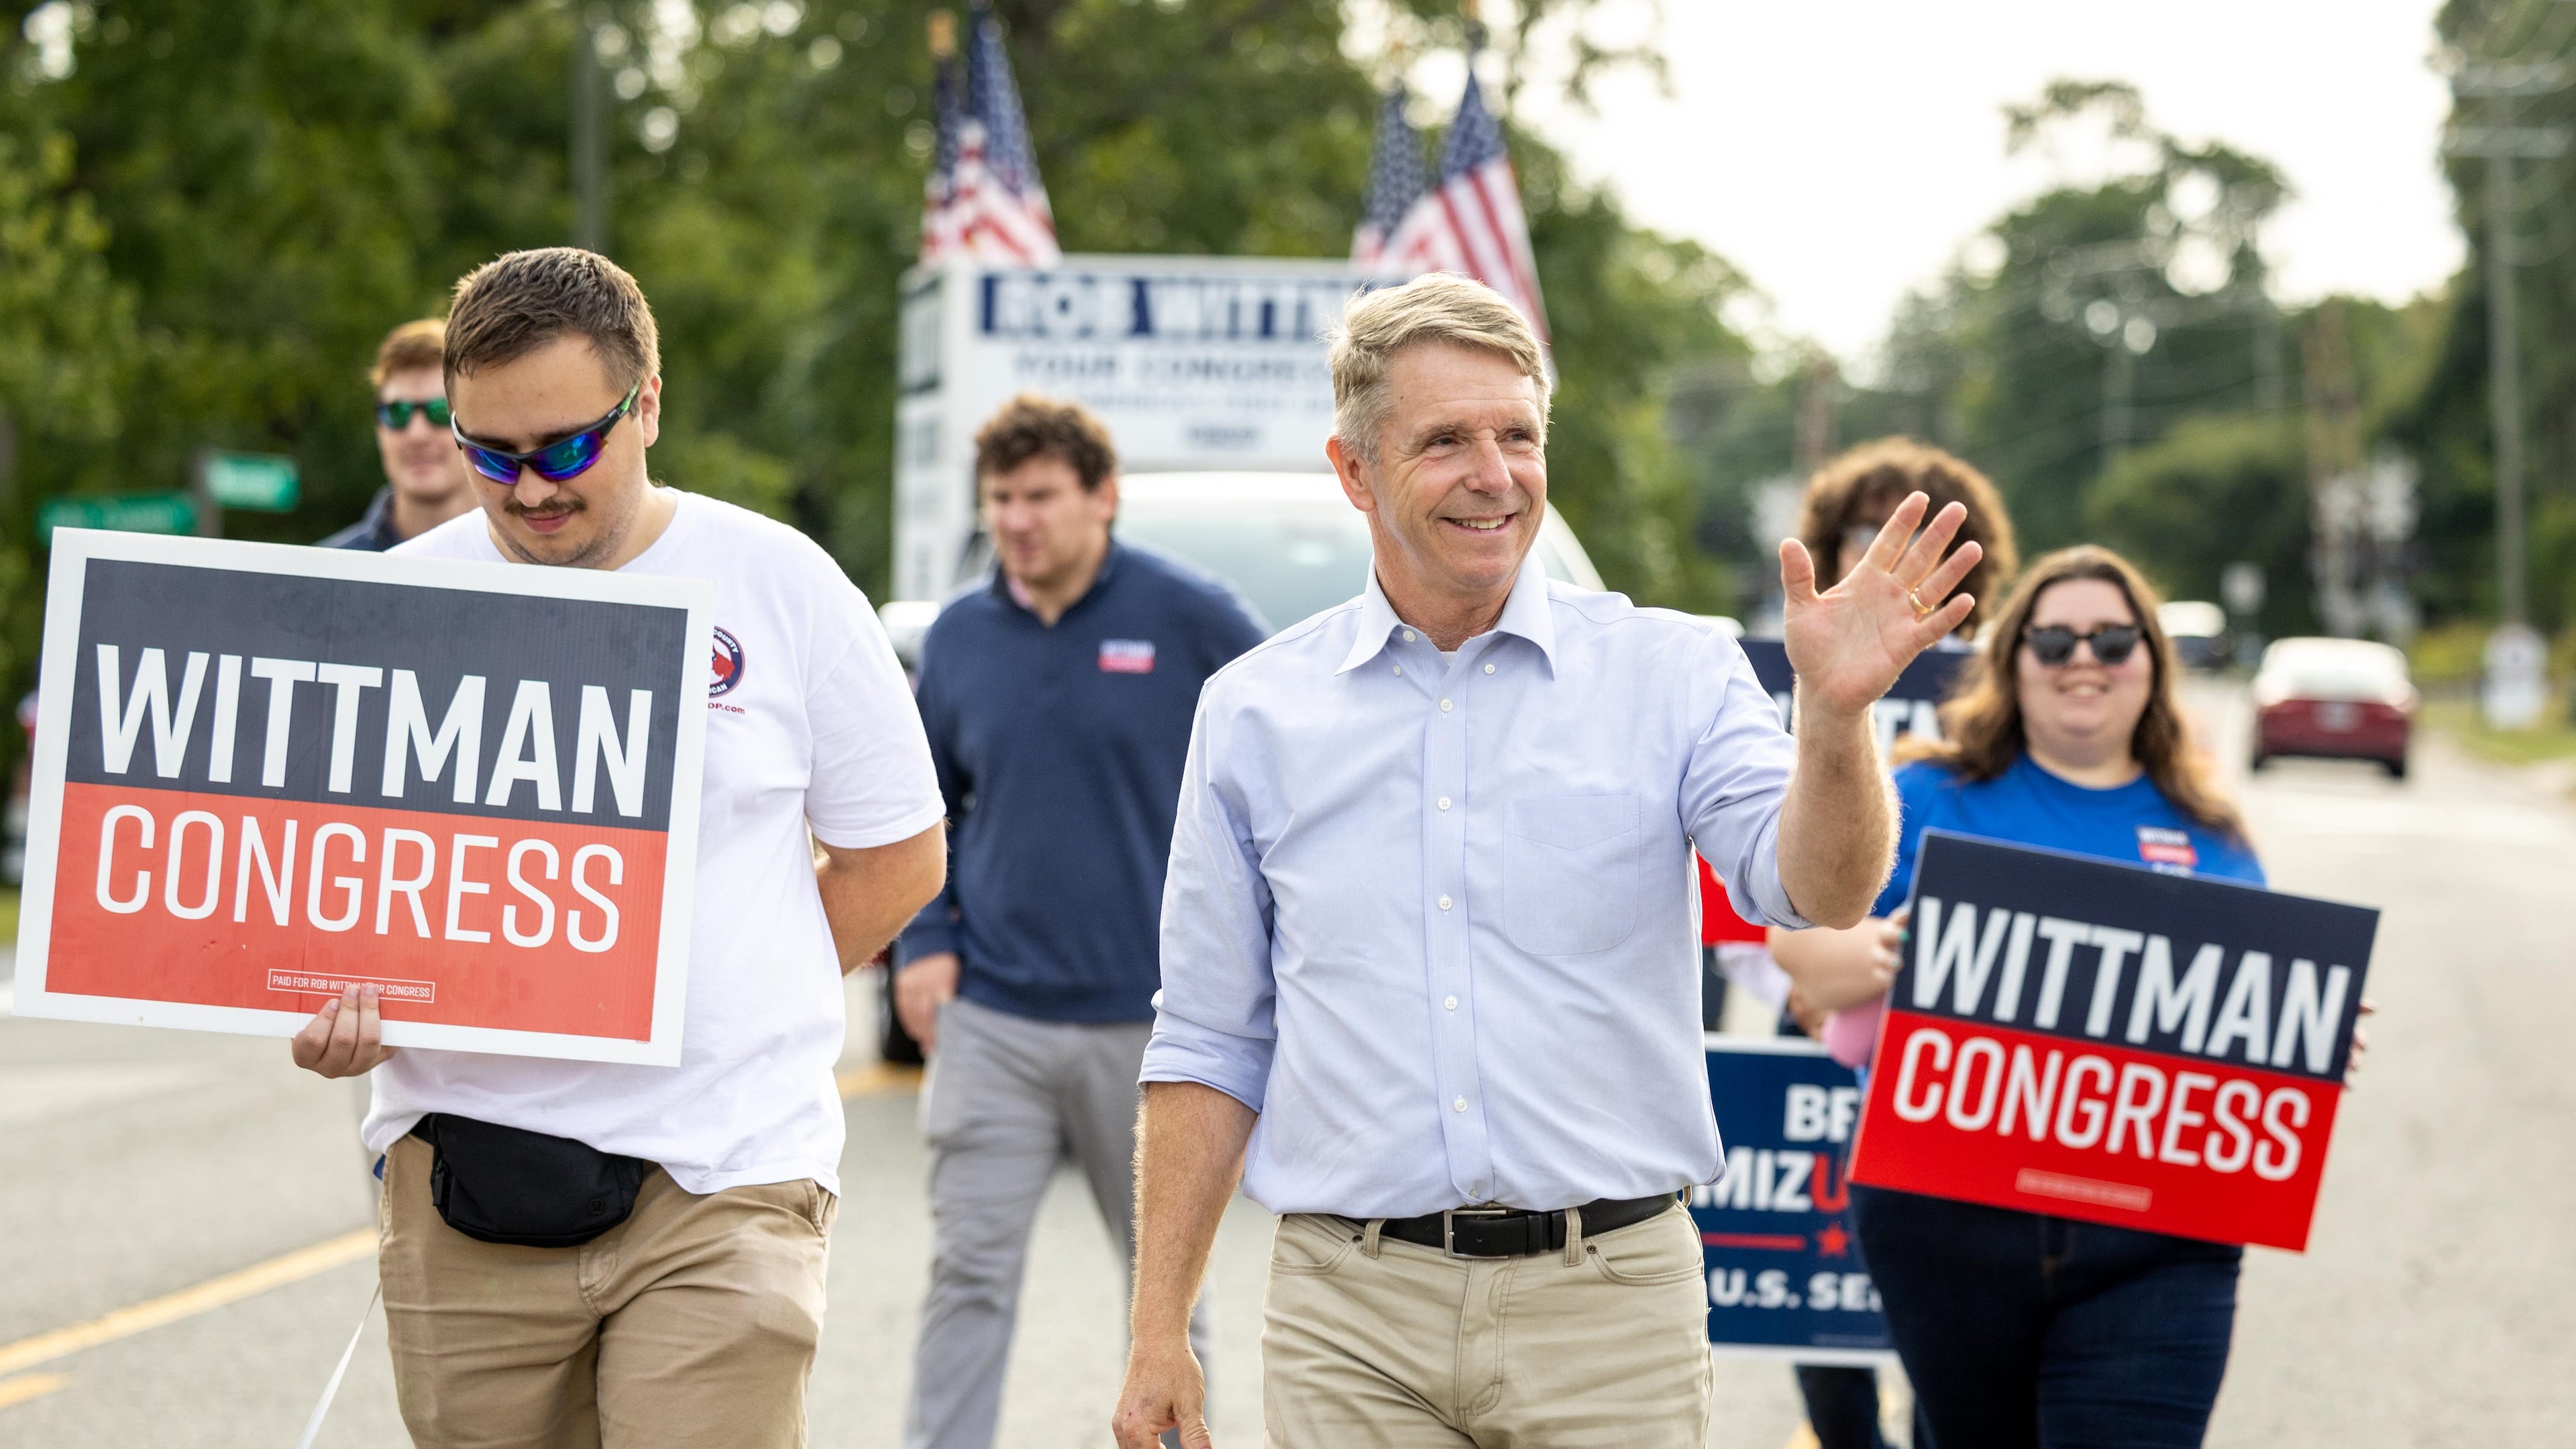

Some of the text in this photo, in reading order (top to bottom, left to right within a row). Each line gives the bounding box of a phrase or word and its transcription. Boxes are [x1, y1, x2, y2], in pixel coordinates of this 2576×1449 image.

[97, 644, 652, 817] WITTMAN
[95, 804, 624, 953] CONGRESS
[272, 975, 292, 987] PAID
[293, 977, 309, 988] FOR
[311, 979, 327, 989] ROB
[386, 984, 430, 998] CONGRESS
[1912, 896, 2351, 1073] WITTMAN
[1893, 1028, 2310, 1181] CONGRESS
[1709, 1268, 1883, 1311] U.S. SE
